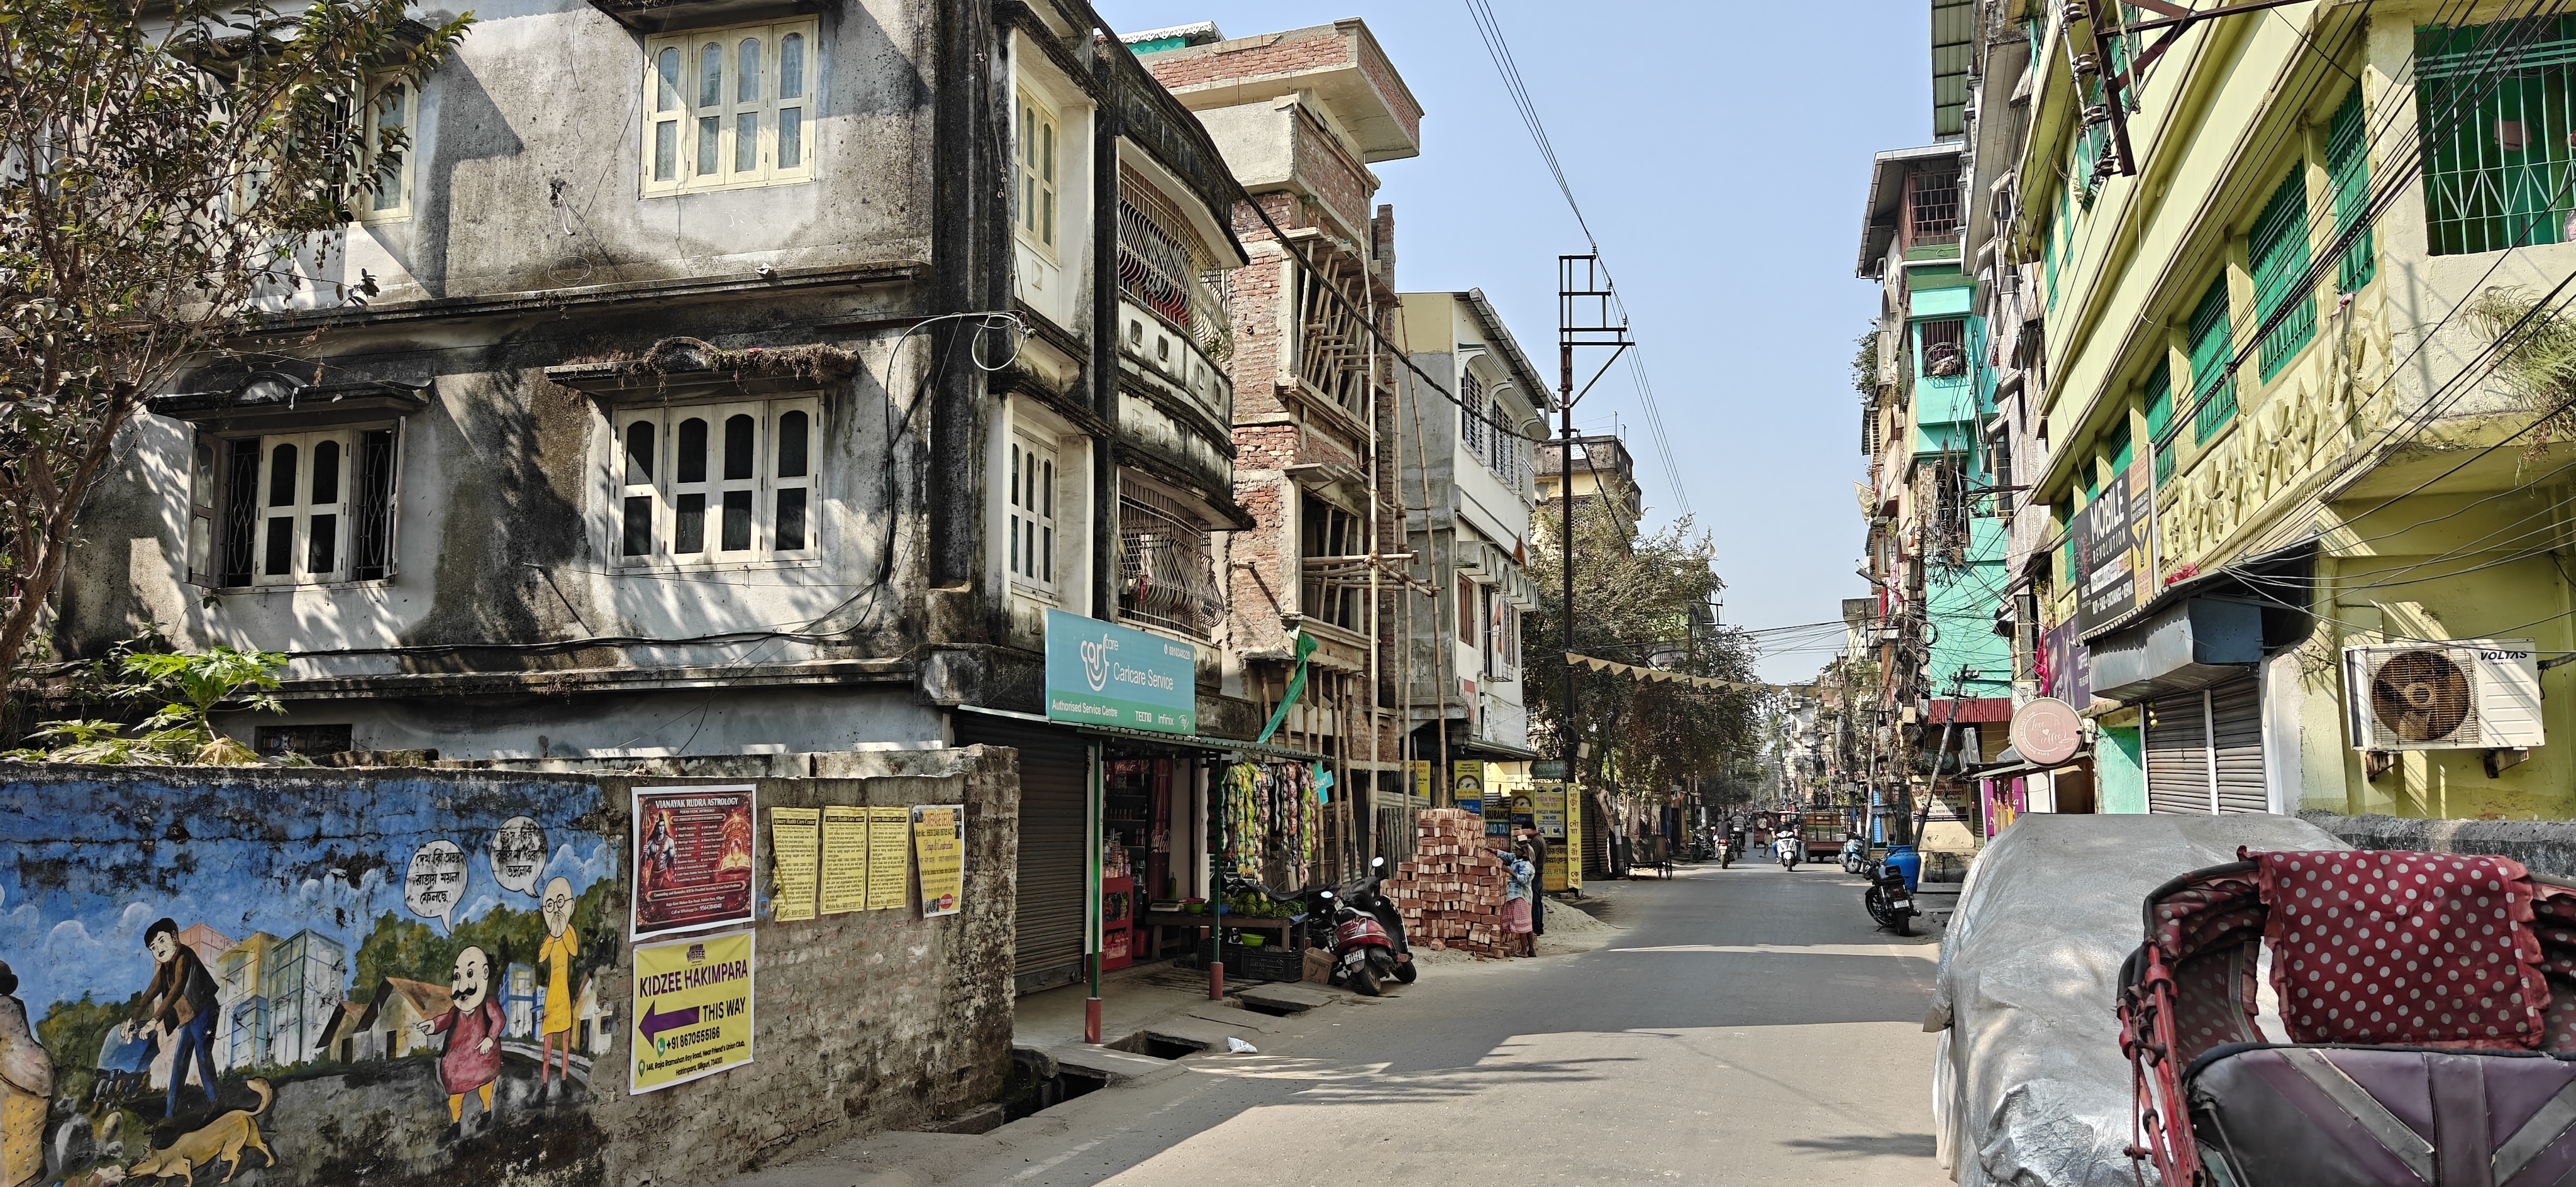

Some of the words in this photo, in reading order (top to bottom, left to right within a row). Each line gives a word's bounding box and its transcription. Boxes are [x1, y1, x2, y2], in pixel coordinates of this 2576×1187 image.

[2090, 478, 2124, 545] MOBILE
[2092, 527, 2126, 564] REVOLUTION
[2480, 650, 2528, 661] VOLTAS
[1113, 662, 1145, 686] Carlcare
[1148, 669, 1174, 690] Service
[1052, 698, 1081, 712] Authorised
[1082, 702, 1101, 715] Service
[1102, 705, 1118, 717] Centre
[1135, 710, 1152, 722] TECNO
[1158, 714, 1174, 726] Infinix
[655, 799, 685, 809] VIANAYAK
[686, 798, 706, 807] RUDRA
[708, 797, 738, 806] ASTROLOGY
[1485, 809, 1511, 820] SURANCE
[1486, 824, 1497, 834] OAD
[1499, 824, 1509, 834] TAX
[1484, 837, 1500, 847] RAFFIC
[441, 872, 460, 884] ময়লা
[640, 971, 682, 998] KIDZEE
[684, 959, 748, 990] HAKIMPARA
[703, 1002, 724, 1022] THIS
[726, 997, 746, 1017] WAY
[666, 1036, 679, 1050] +91
[680, 1026, 720, 1047] 8670555166
[702, 1048, 711, 1056] Near
[726, 1042, 735, 1051] Union
